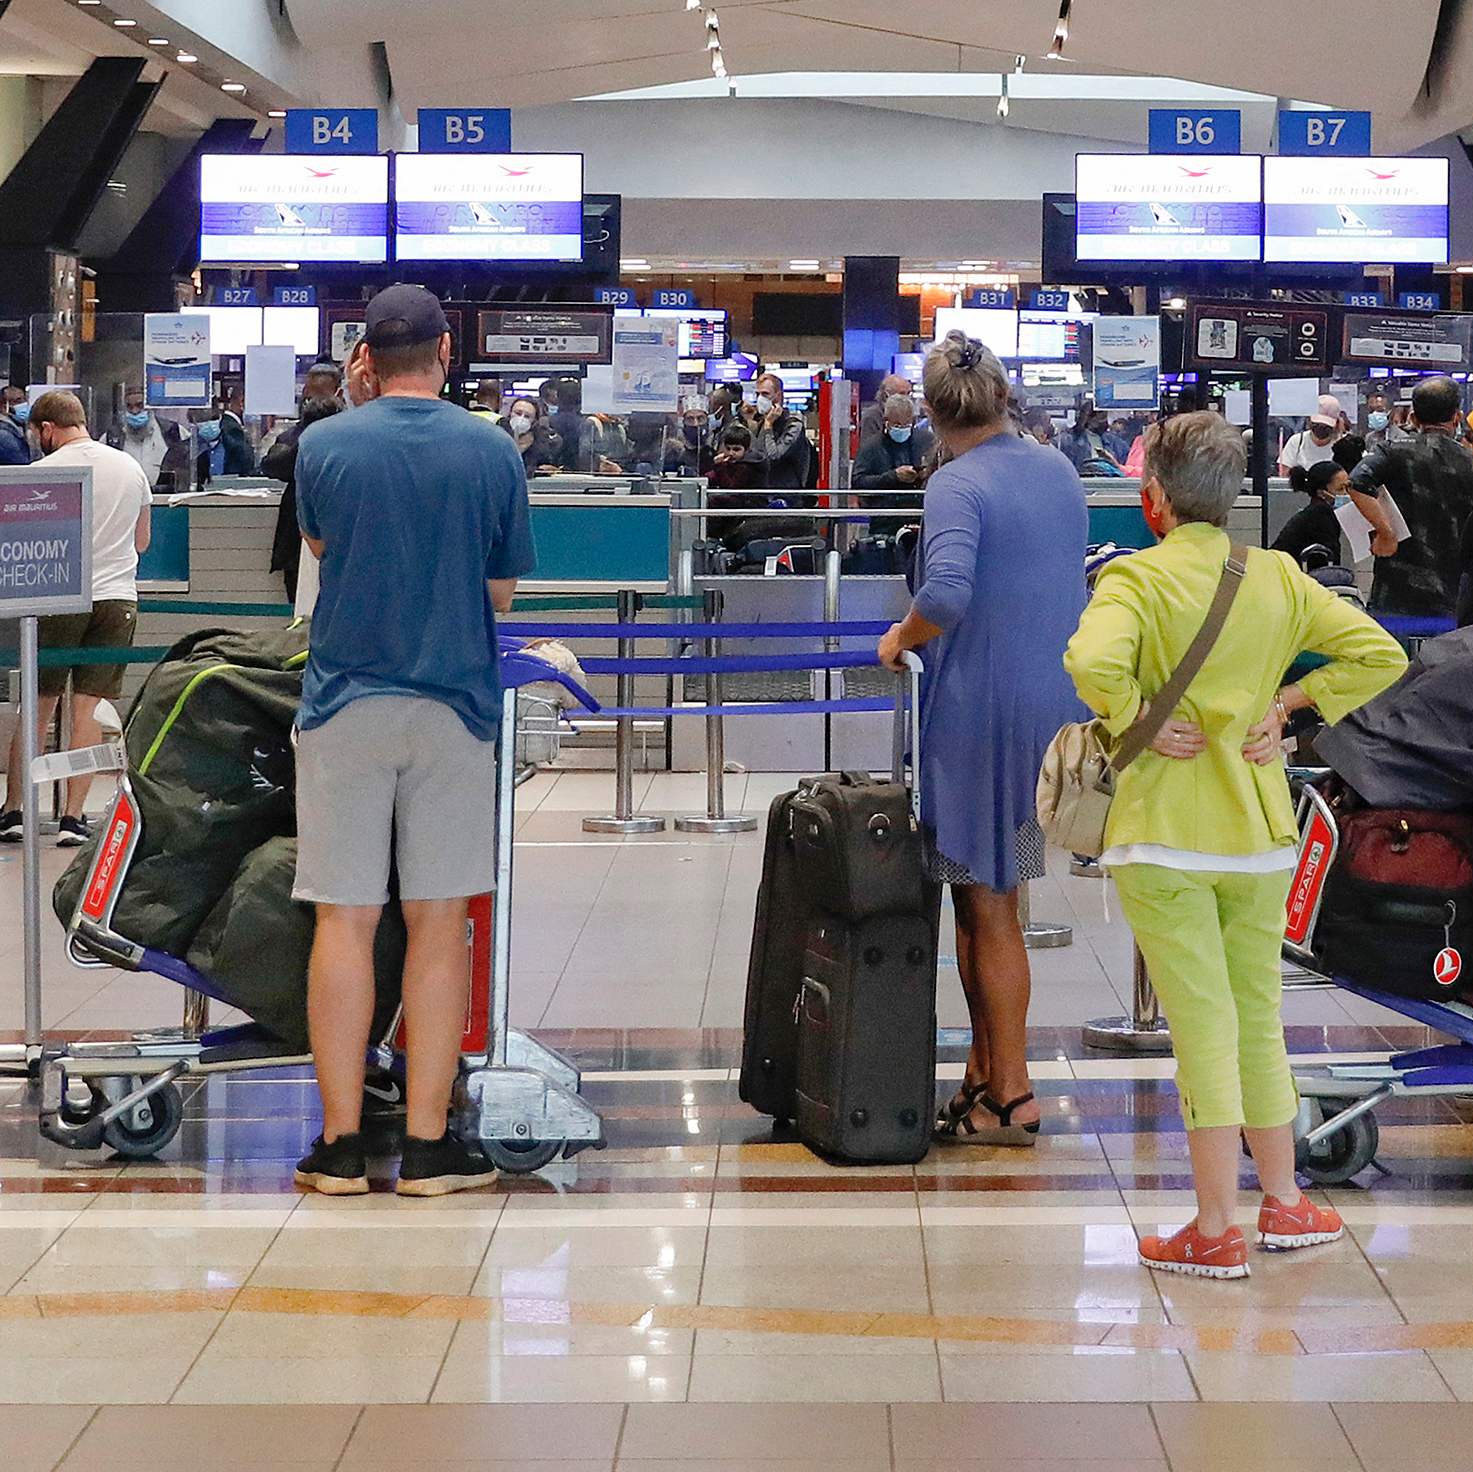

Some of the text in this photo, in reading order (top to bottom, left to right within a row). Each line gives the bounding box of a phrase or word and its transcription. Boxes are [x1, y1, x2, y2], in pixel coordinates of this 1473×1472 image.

[312, 116, 353, 144] B4
[445, 116, 484, 143] B5
[1176, 117, 1215, 145] B6
[1306, 118, 1346, 146] B7
[224, 290, 250, 303] B27
[282, 291, 309, 303] B28
[602, 292, 628, 304] B29
[660, 293, 687, 305] B30
[980, 293, 1005, 305] B31
[1037, 294, 1063, 306] B32
[1351, 296, 1377, 307] B33
[1406, 296, 1433, 308] B34
[96, 842, 120, 890] SPAR
[1294, 863, 1316, 913] SPAR
